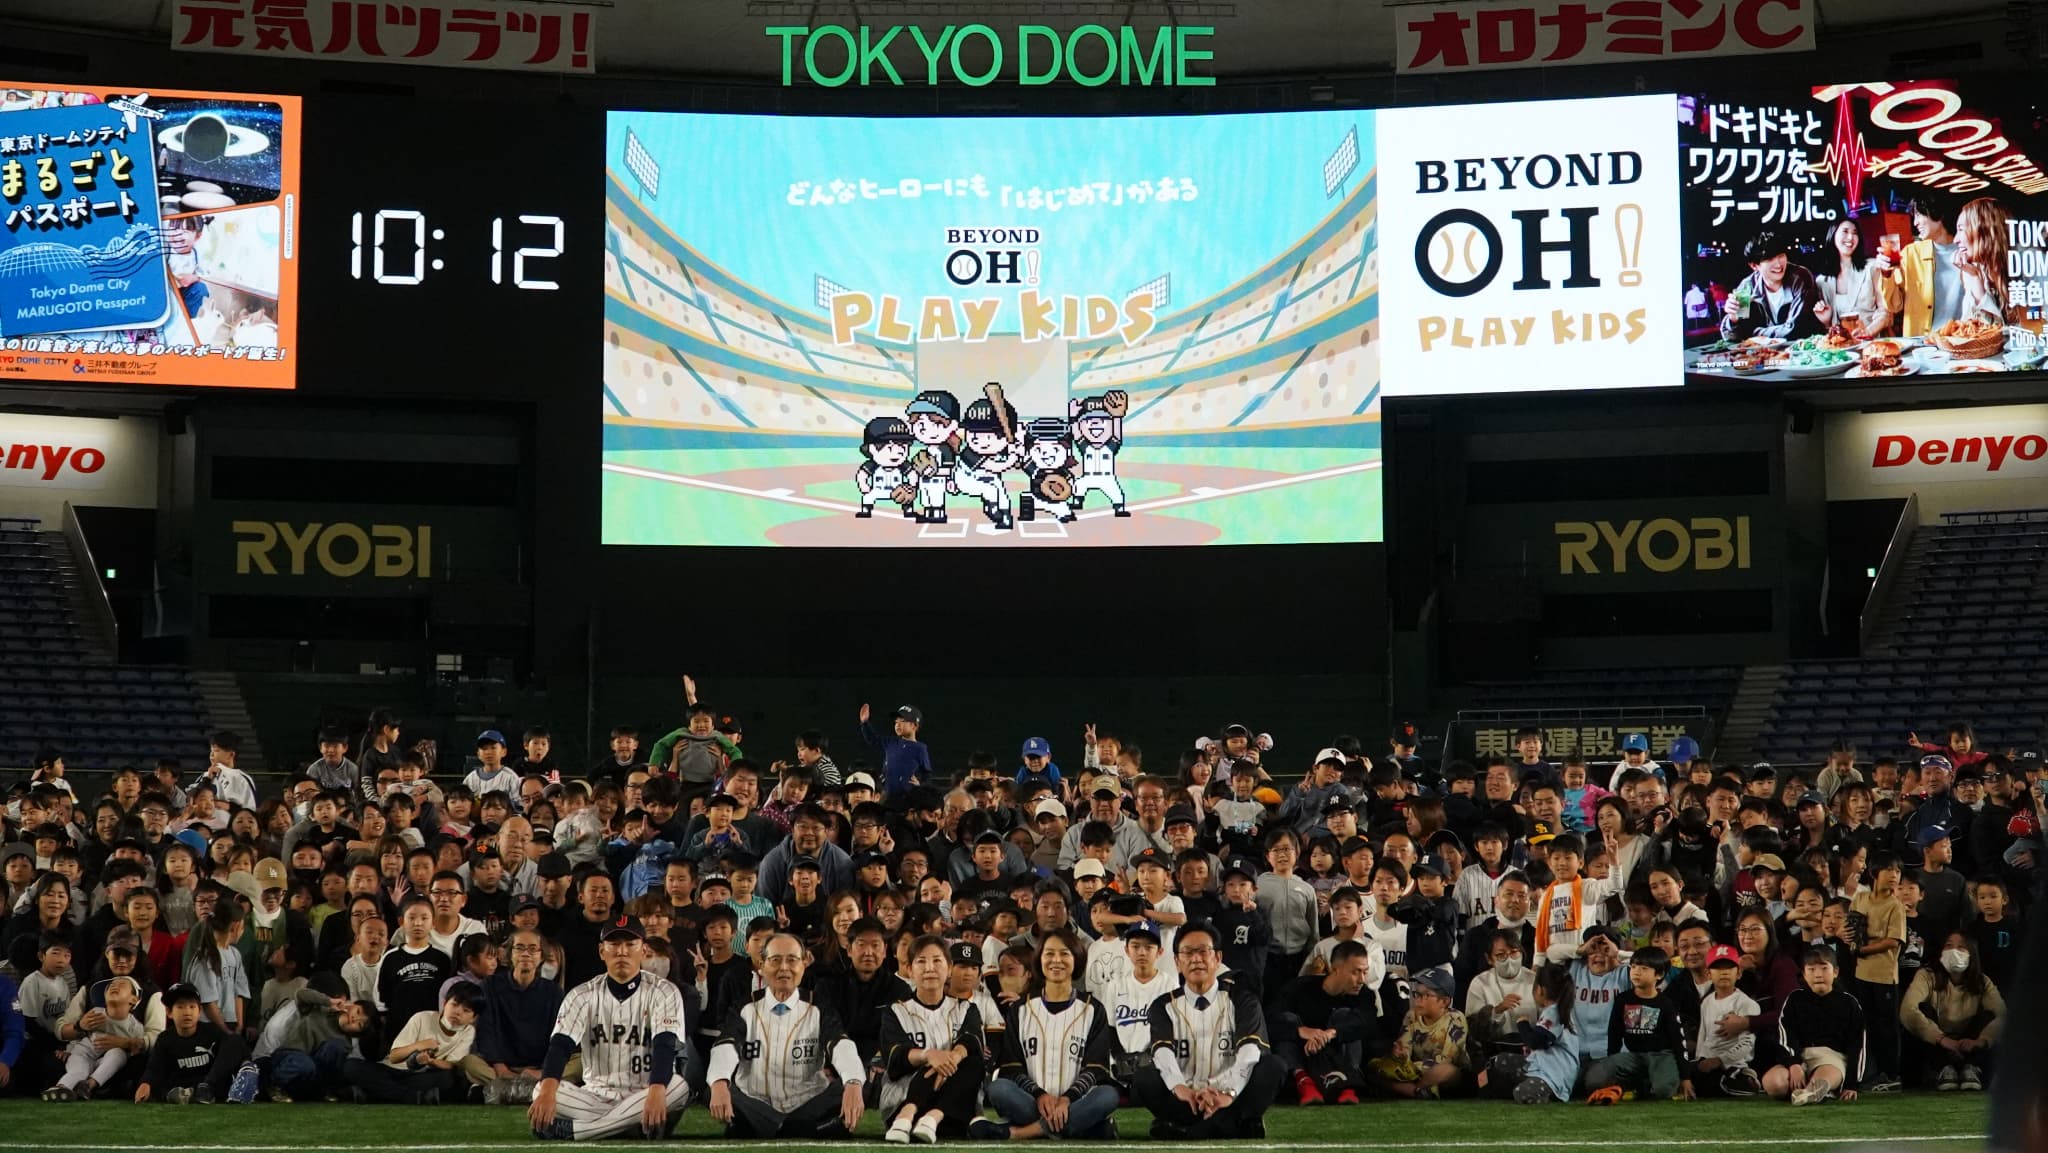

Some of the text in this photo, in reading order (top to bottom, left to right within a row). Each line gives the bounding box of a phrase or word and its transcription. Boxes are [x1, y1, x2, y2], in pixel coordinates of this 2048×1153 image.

[1407, 0, 1804, 69] オロナミンC
[765, 24, 1216, 87] TOKYO DOME
[1, 126, 127, 153] 東京ドームシティ
[1708, 103, 1823, 146] ドキドキと
[2, 149, 131, 198] まるごと
[1415, 151, 1643, 195] BEYOND
[1689, 148, 1818, 185] ワクワクを、
[1886, 150, 1990, 193] TOKYO
[6, 191, 135, 226] パスポート
[787, 174, 990, 207] どんなヒーローにも
[1711, 187, 1837, 226] テーブルに。
[947, 229, 1040, 244] BEYOND
[1414, 203, 1645, 298] OH!
[946, 250, 1040, 286] OH!
[17, 295, 146, 319] MARUGOTO Passport
[30, 279, 131, 300] Tokyo Dome City
[832, 290, 1157, 345] PLAY KIDS
[1418, 308, 1647, 352] PLAY KIDS
[0, 444, 105, 480] nyo
[1872, 433, 2047, 471] Denyo
[232, 520, 431, 578] RYOBI
[1553, 515, 1751, 574] RYOBI
[616, 914, 629, 929] J
[177, 1053, 210, 1069] PUMA
[632, 1054, 653, 1074] 89
